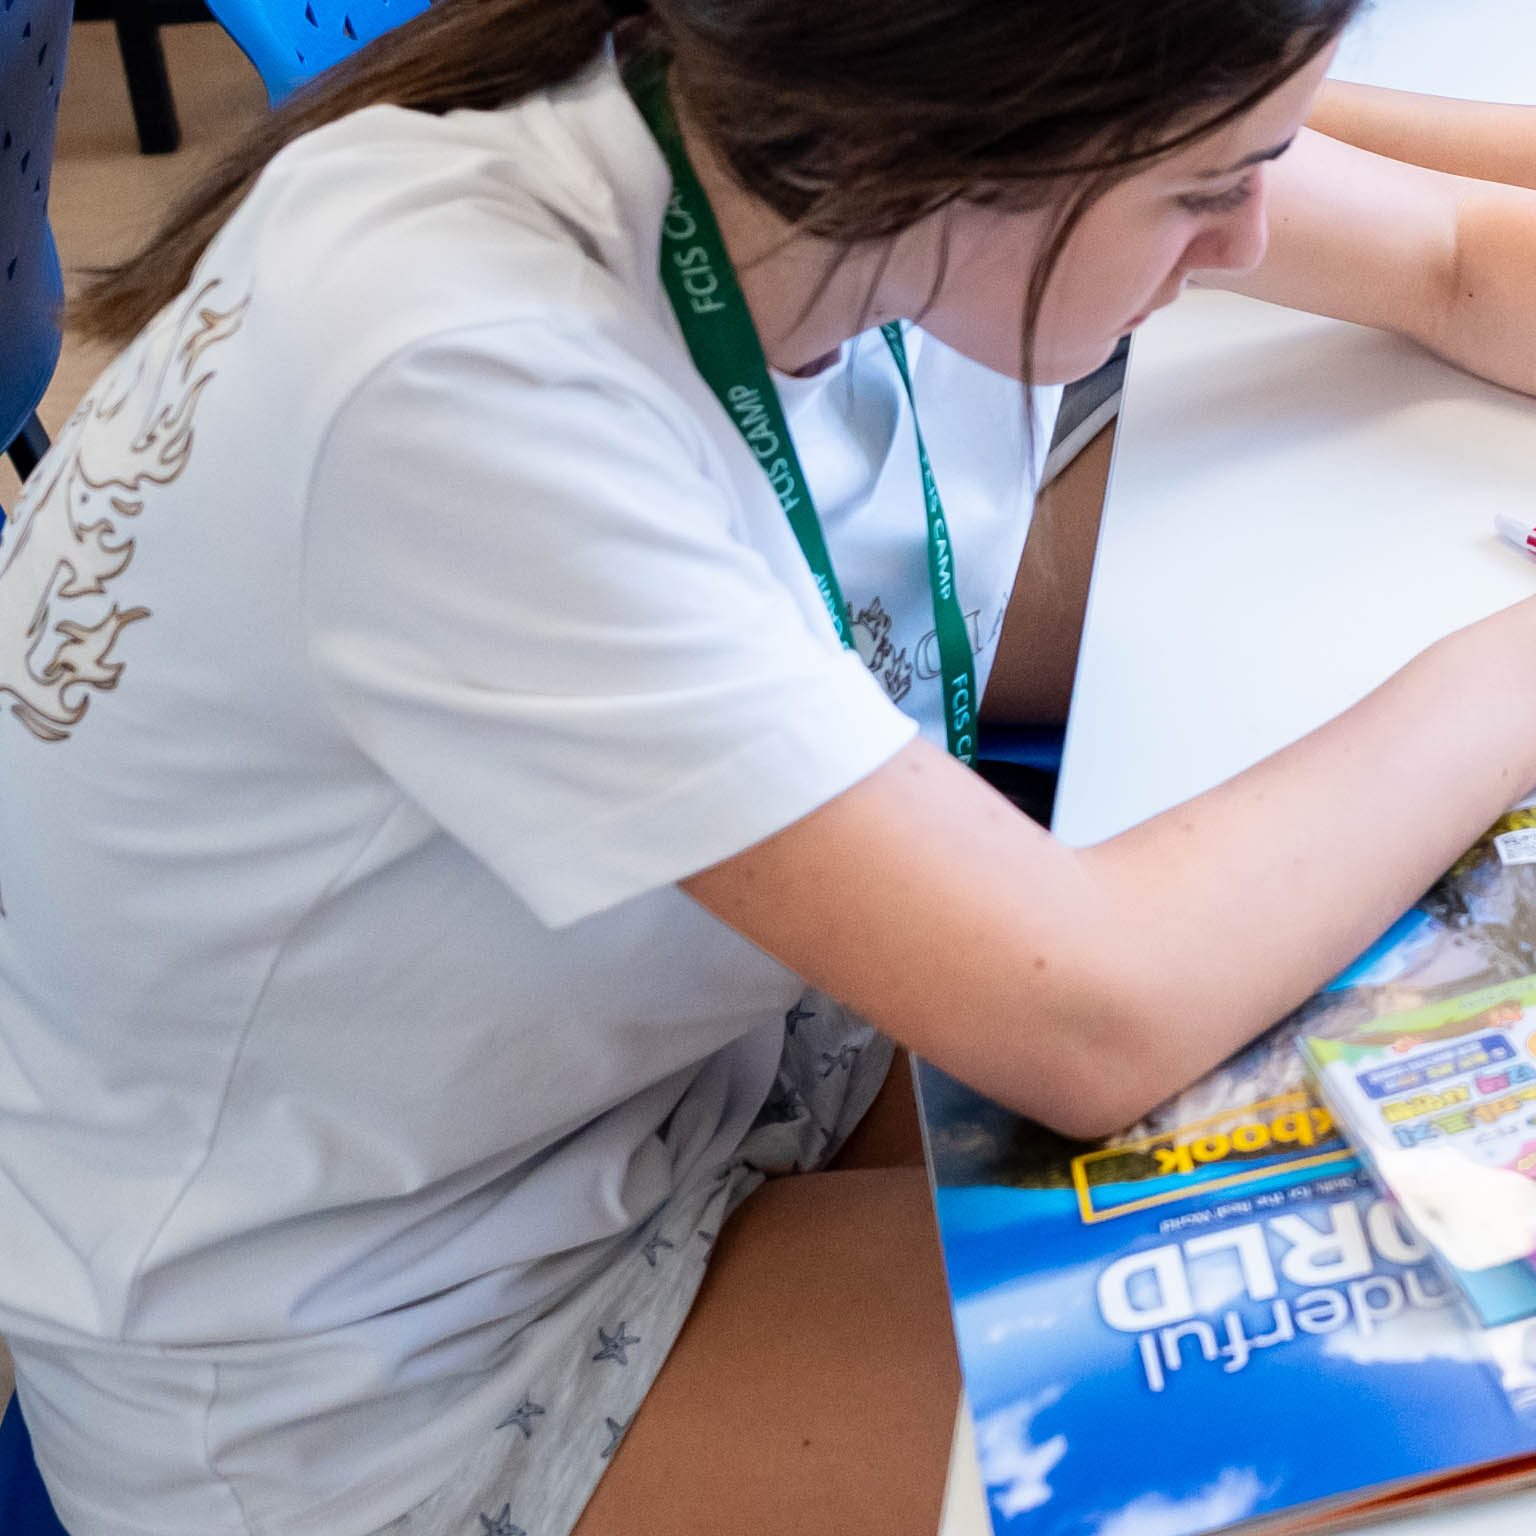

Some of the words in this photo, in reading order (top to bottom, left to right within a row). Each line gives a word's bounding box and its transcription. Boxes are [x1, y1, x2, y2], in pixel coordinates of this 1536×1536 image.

[672, 243, 726, 315] FCIS
[727, 384, 780, 476] CAMP
[769, 458, 800, 514] FCIS
[932, 518, 951, 602] CAMP
[951, 671, 970, 732] FCIS
[1097, 1199, 1432, 1333] ORLD
